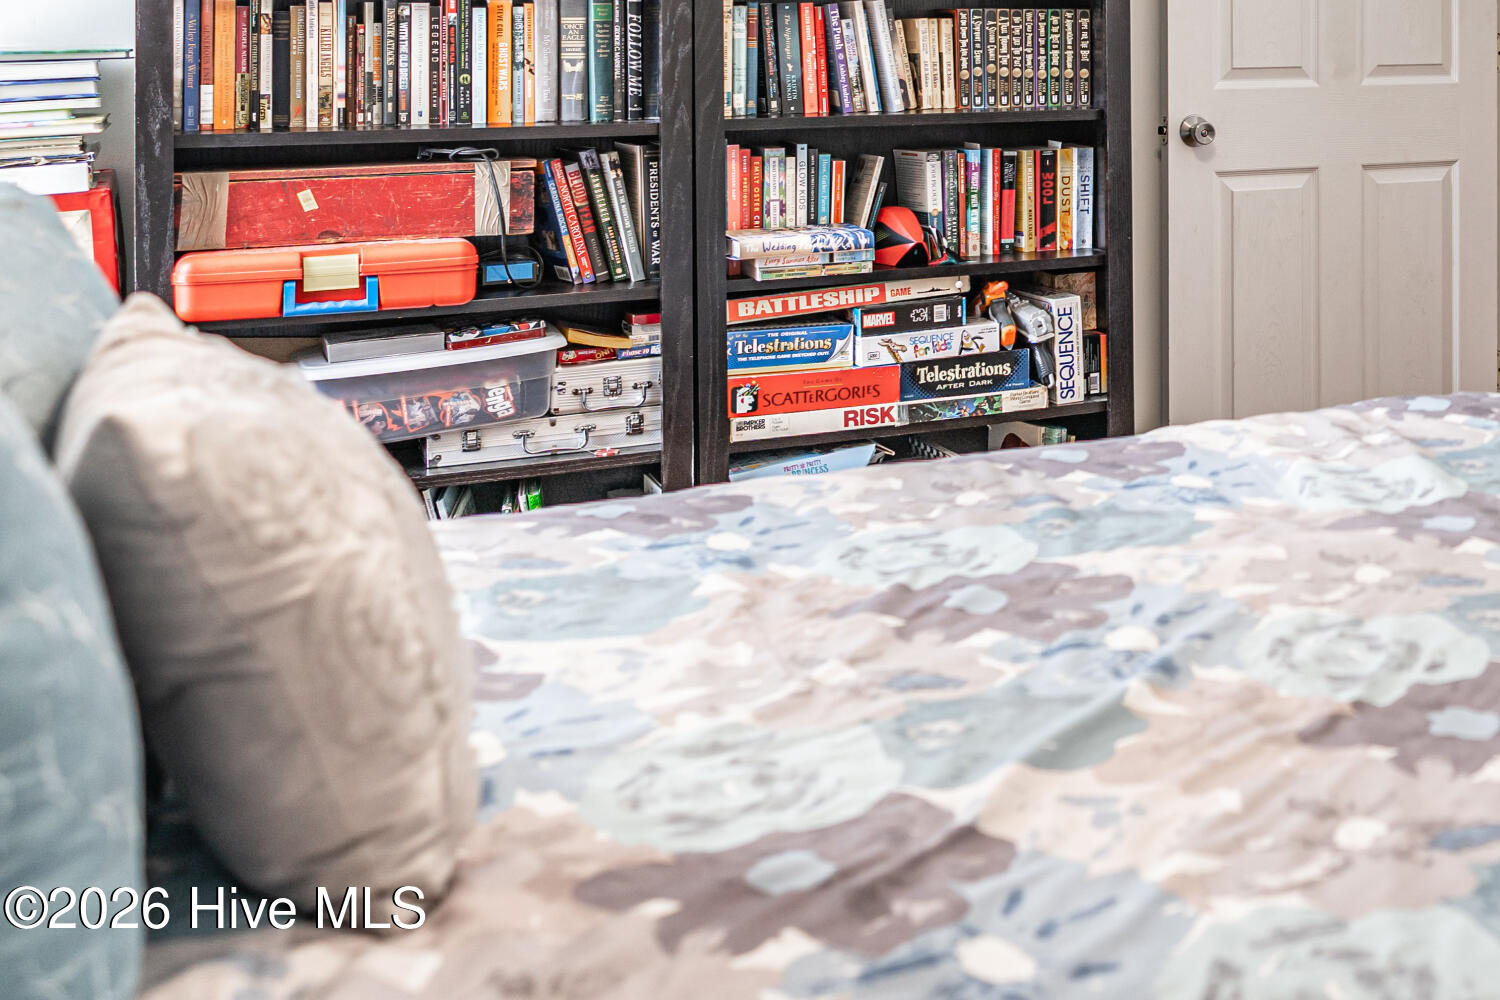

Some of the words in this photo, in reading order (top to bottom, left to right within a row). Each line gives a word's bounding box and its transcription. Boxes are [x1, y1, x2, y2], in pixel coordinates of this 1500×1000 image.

[387, 8, 395, 37] INFANTRY
[830, 9, 840, 27] The
[187, 19, 196, 41] Valley
[321, 28, 331, 51] KILLER
[400, 22, 408, 40] WITH
[834, 27, 843, 50] Push
[986, 26, 996, 43] SECOND
[186, 43, 196, 62] Forge
[387, 39, 395, 66] ATTACKS
[400, 41, 408, 53] THE
[628, 14, 642, 72] FOLLOW
[784, 27, 793, 60] Nightingale
[987, 45, 996, 61] CHANCE
[400, 54, 408, 67] OLD
[499, 42, 507, 67] GHOST
[187, 64, 196, 88] Winter
[321, 54, 331, 78] ANGELS
[839, 63, 847, 83] Ashley
[400, 68, 408, 89] BREED
[499, 70, 507, 91] WARS
[629, 75, 642, 96] ME
[842, 84, 850, 108] Audrain
[568, 170, 588, 204] BLOOD
[579, 205, 596, 234] YEAR
[590, 173, 610, 223] JAWBREAKER
[649, 161, 660, 228] PRESIDENTS
[1061, 176, 1070, 216] DUST
[1080, 175, 1090, 214] SHIFT
[560, 185, 574, 214] NORTH
[570, 215, 585, 256] CAROLINA
[652, 241, 661, 265] WAR
[762, 241, 796, 253] Wedding
[738, 286, 880, 317] BATTLESHIP
[890, 287, 912, 297] GAME
[862, 313, 895, 327] MARVEL
[735, 337, 832, 355] Telestrations
[909, 332, 954, 345] SEQUENCE
[914, 344, 931, 359] for
[932, 340, 952, 354] kids
[1057, 306, 1075, 400] SEQUENCE
[917, 361, 1012, 384] Telestrations
[762, 384, 880, 407] SCATTERGORIES
[936, 381, 965, 390] AFTER
[969, 379, 993, 387] DARK
[843, 406, 896, 428] RISK
[784, 464, 799, 472] PRETTY
[792, 464, 828, 475] PRINCESS
